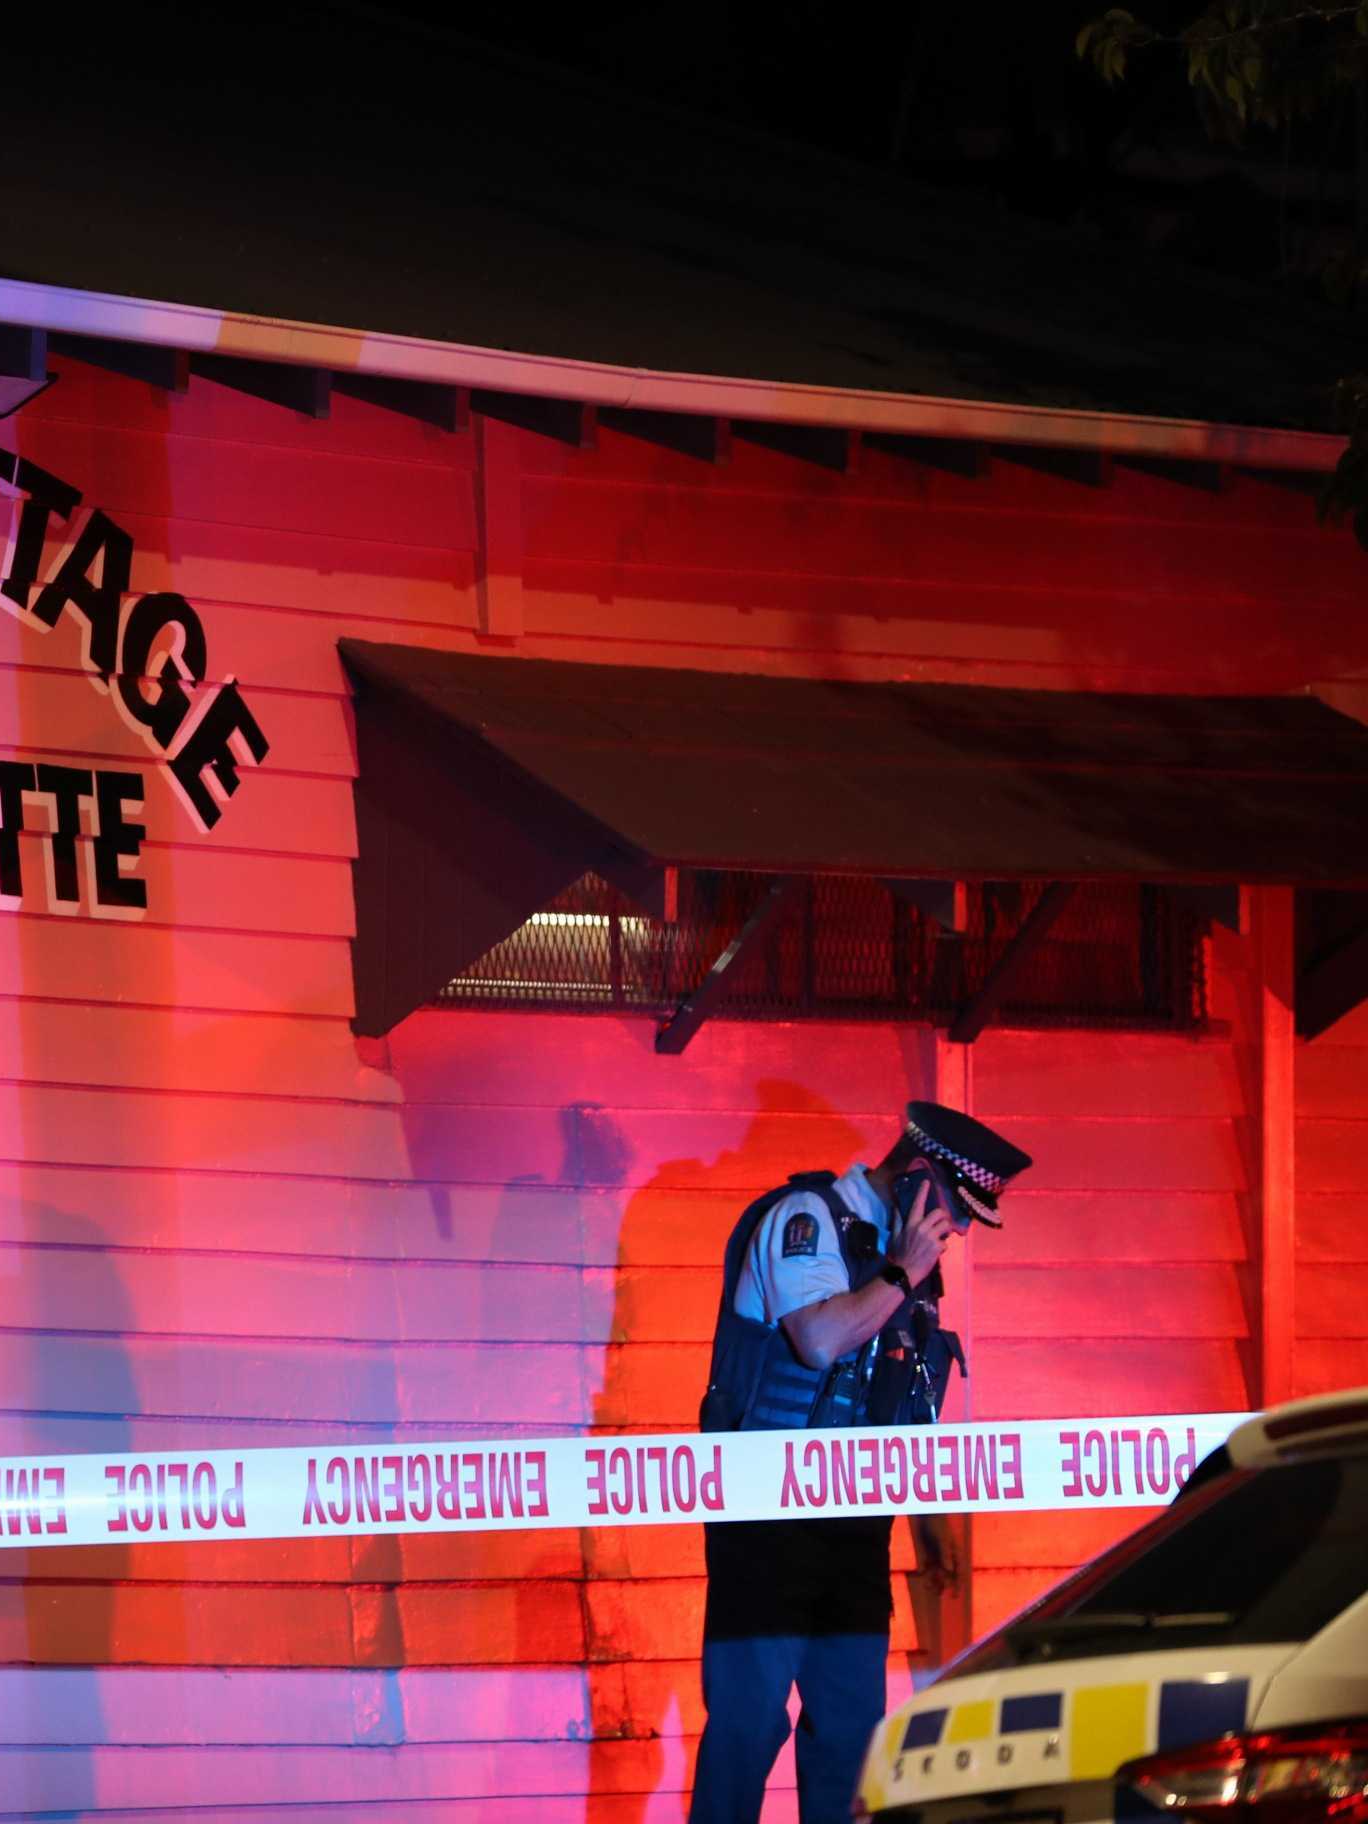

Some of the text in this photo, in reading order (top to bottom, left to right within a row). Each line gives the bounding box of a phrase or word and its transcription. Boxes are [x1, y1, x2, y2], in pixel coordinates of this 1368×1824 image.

[105, 1461, 247, 1532] POLICE
[302, 1450, 550, 1526] EMERGENCY
[585, 1444, 726, 1516] POLICE
[780, 1433, 1025, 1508] EMERGENCY
[1059, 1427, 1197, 1498] POLICE
